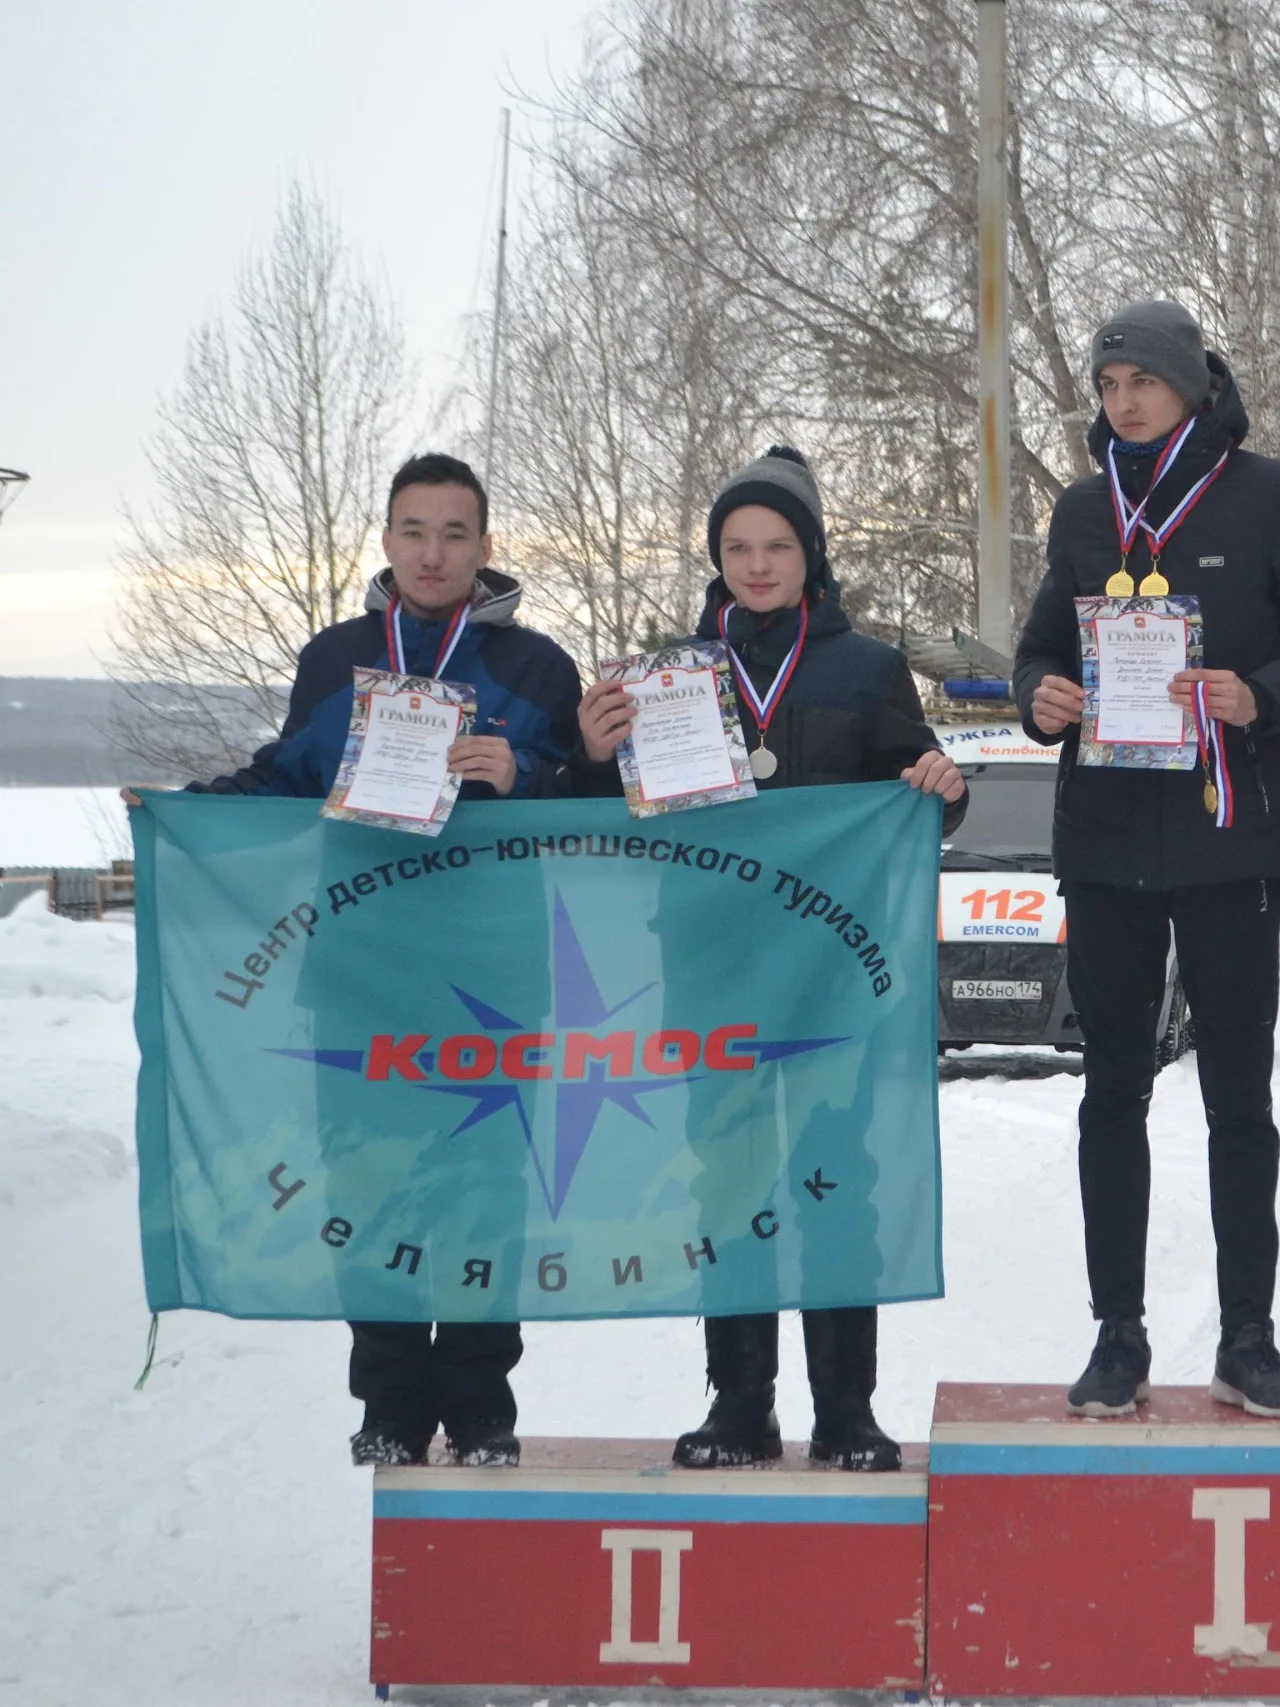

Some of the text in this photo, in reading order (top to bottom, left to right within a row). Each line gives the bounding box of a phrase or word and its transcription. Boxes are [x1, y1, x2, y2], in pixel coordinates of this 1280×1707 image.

[1106, 630, 1176, 643] ГРАМОТА
[378, 708, 448, 730] ГРАМОТА
[980, 745, 1060, 757] Челябинс
[215, 834, 897, 1009] Центр детско-юношеского туризма
[961, 889, 1046, 922] 112
[962, 925, 1039, 937] EMERCOM
[365, 1023, 759, 1082] КОСМОС
[267, 1161, 839, 1293] Челябинск
[600, 1528, 692, 1664] II
